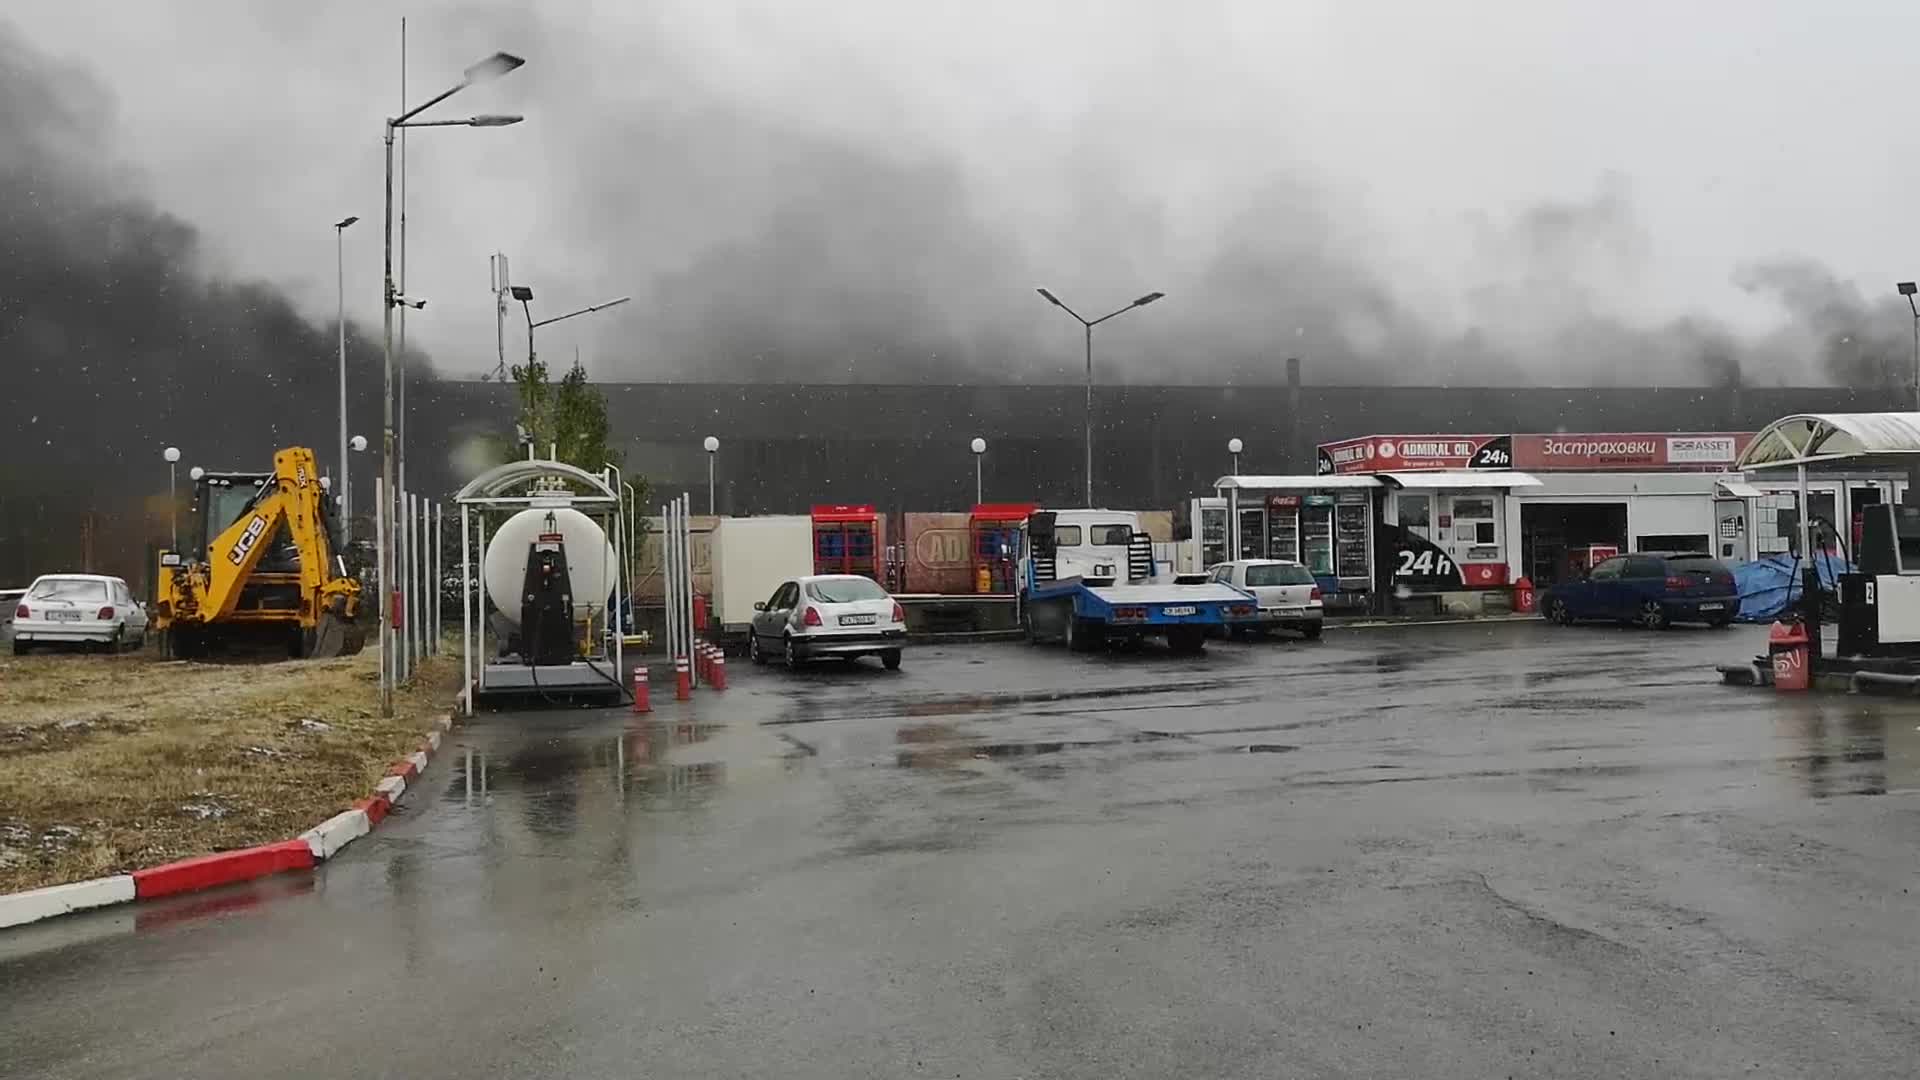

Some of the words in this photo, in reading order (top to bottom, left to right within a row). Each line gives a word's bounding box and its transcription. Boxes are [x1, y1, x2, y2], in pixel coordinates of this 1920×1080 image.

[1402, 442, 1450, 456] ADMIRAL
[1454, 442, 1471, 456] OIL
[1543, 438, 1657, 457] Застраховки
[1695, 441, 1731, 450] ASSET
[1480, 449, 1509, 464] 24h
[230, 515, 266, 565] JCB
[1395, 550, 1451, 575] 24h
[1866, 585, 1873, 600] 2
